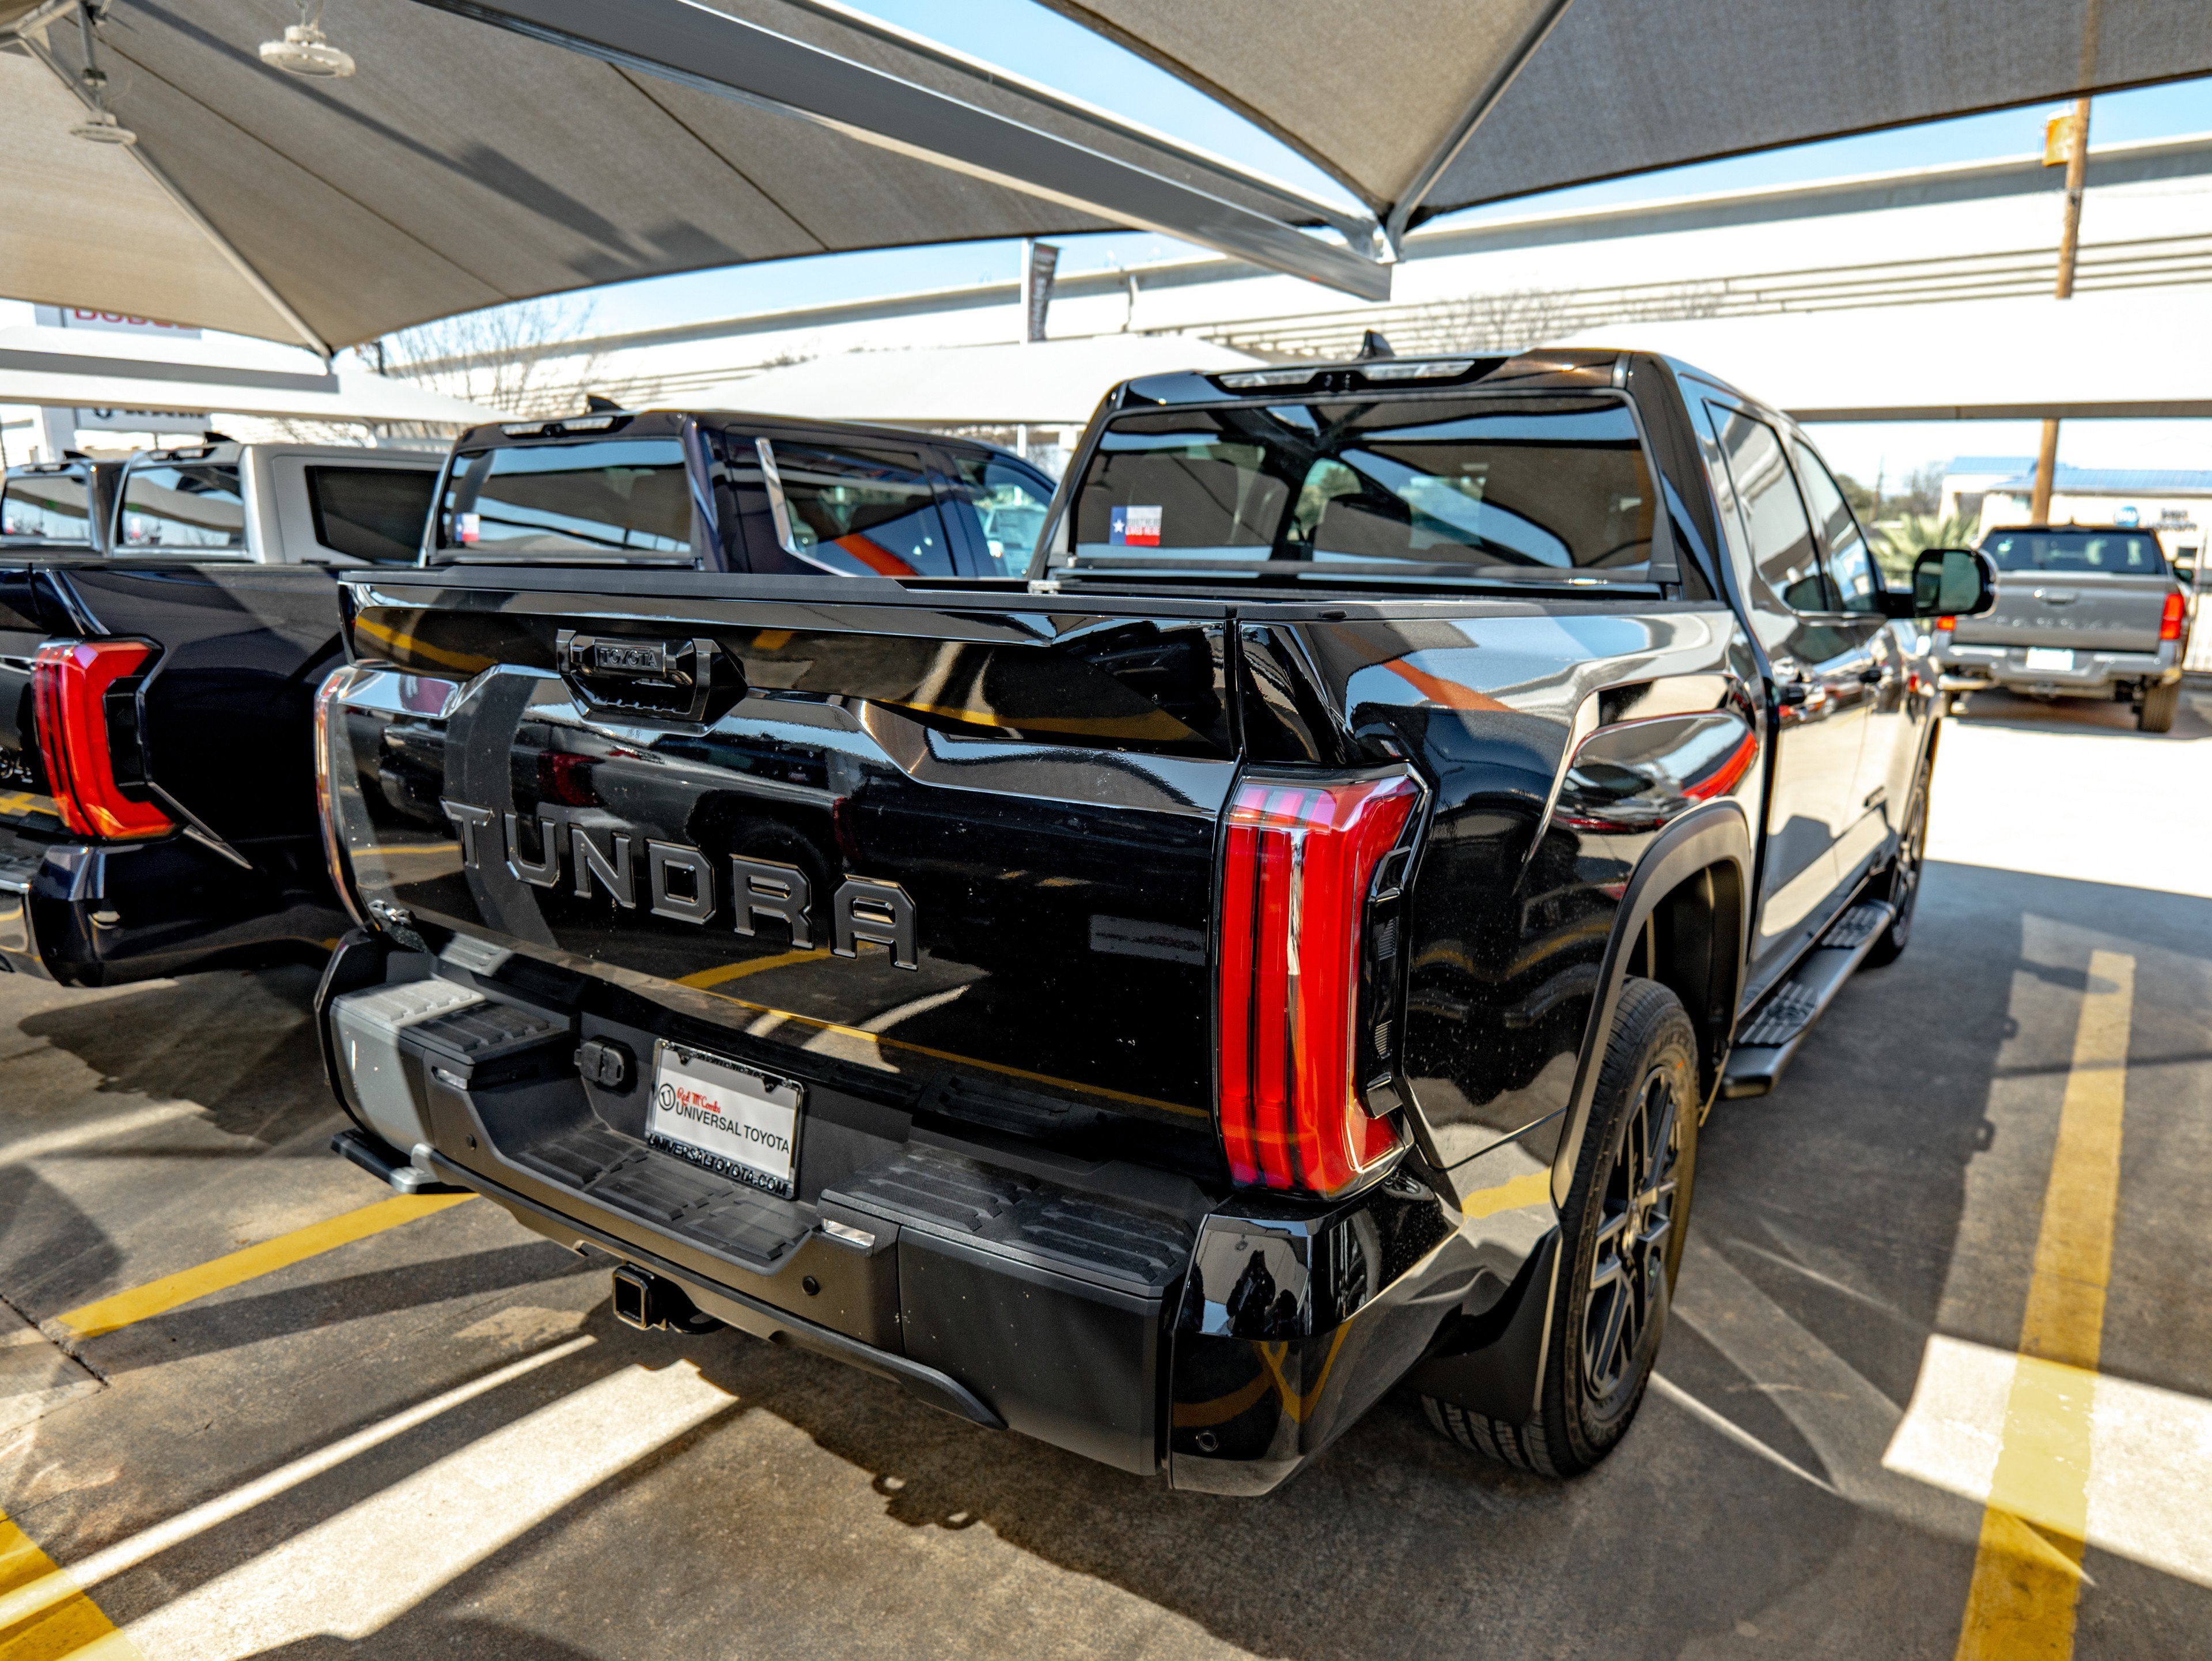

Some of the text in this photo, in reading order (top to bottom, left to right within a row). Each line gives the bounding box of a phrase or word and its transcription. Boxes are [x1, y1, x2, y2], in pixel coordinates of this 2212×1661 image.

[600, 647, 657, 668] TOYOTA
[440, 797, 918, 971] TUNDRA
[677, 1087, 690, 1106] Red
[676, 1101, 790, 1154] UNIVERSAL TOYOTA
[648, 1133, 789, 1197] UNIVERSALTOYOTA.COM
